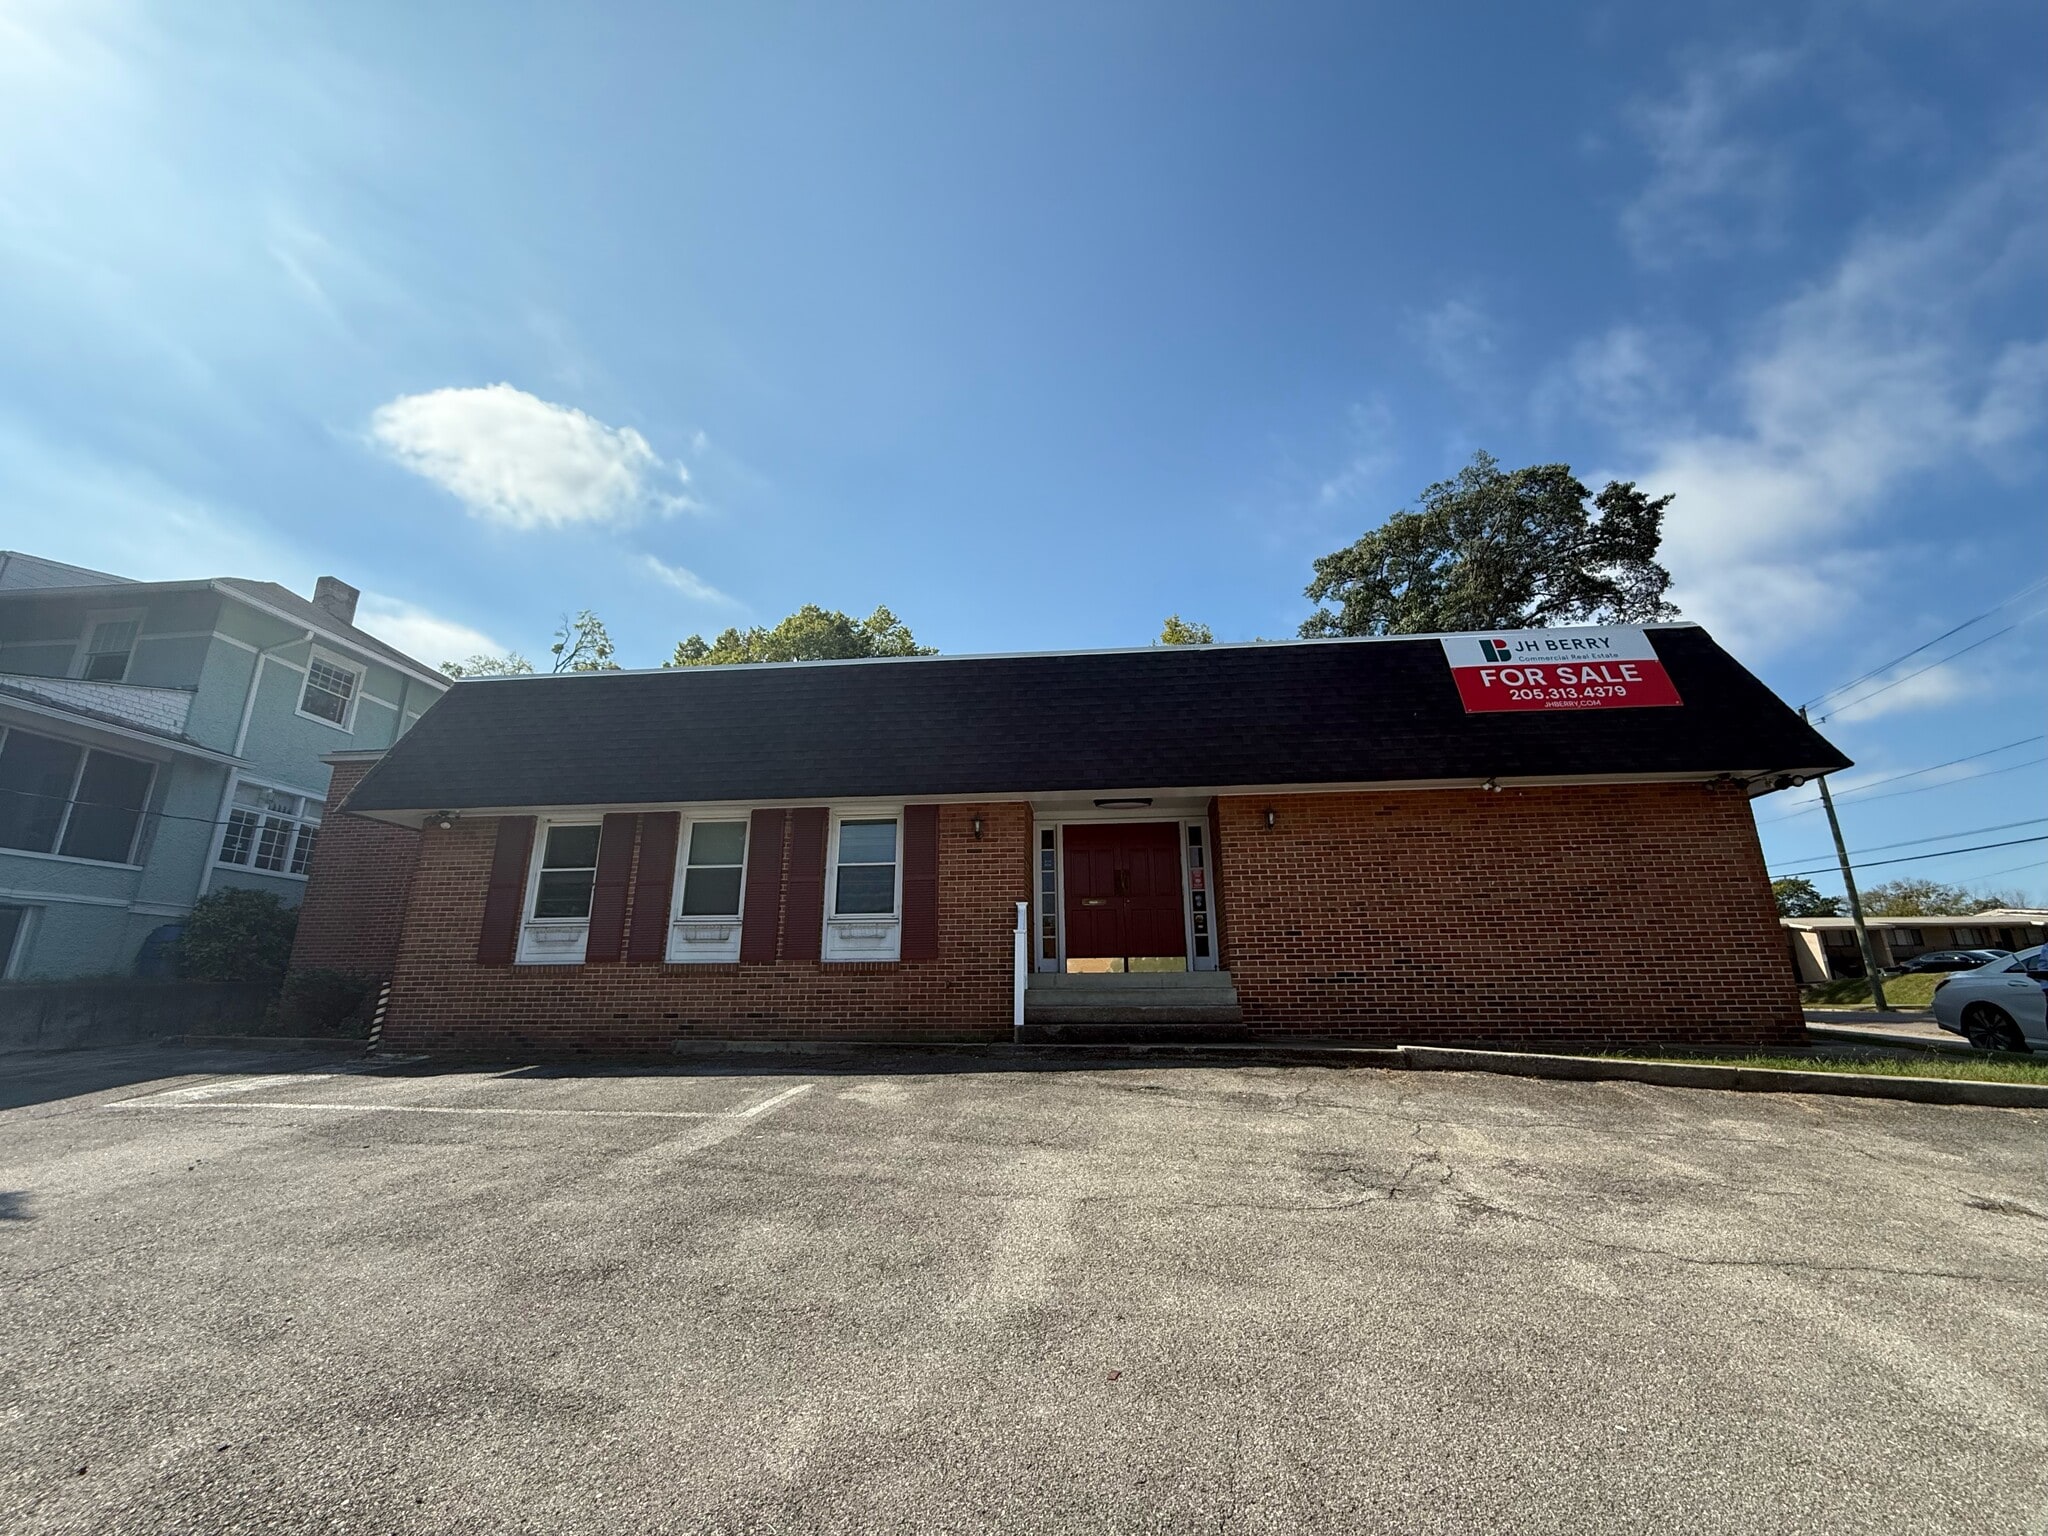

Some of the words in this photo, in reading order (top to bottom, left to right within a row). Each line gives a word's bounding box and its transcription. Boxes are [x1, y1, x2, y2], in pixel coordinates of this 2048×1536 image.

[1515, 640, 1540, 652] JH
[1545, 637, 1610, 651] BERRY
[1518, 654, 1569, 662] Commercial
[1570, 653, 1590, 661] Real
[1591, 652, 1619, 660] Estate
[1480, 668, 1548, 687] FOR
[1556, 664, 1643, 684] SALE
[1509, 686, 1627, 700] 205.313.4379
[1544, 699, 1601, 708] JHBERRY.COM
